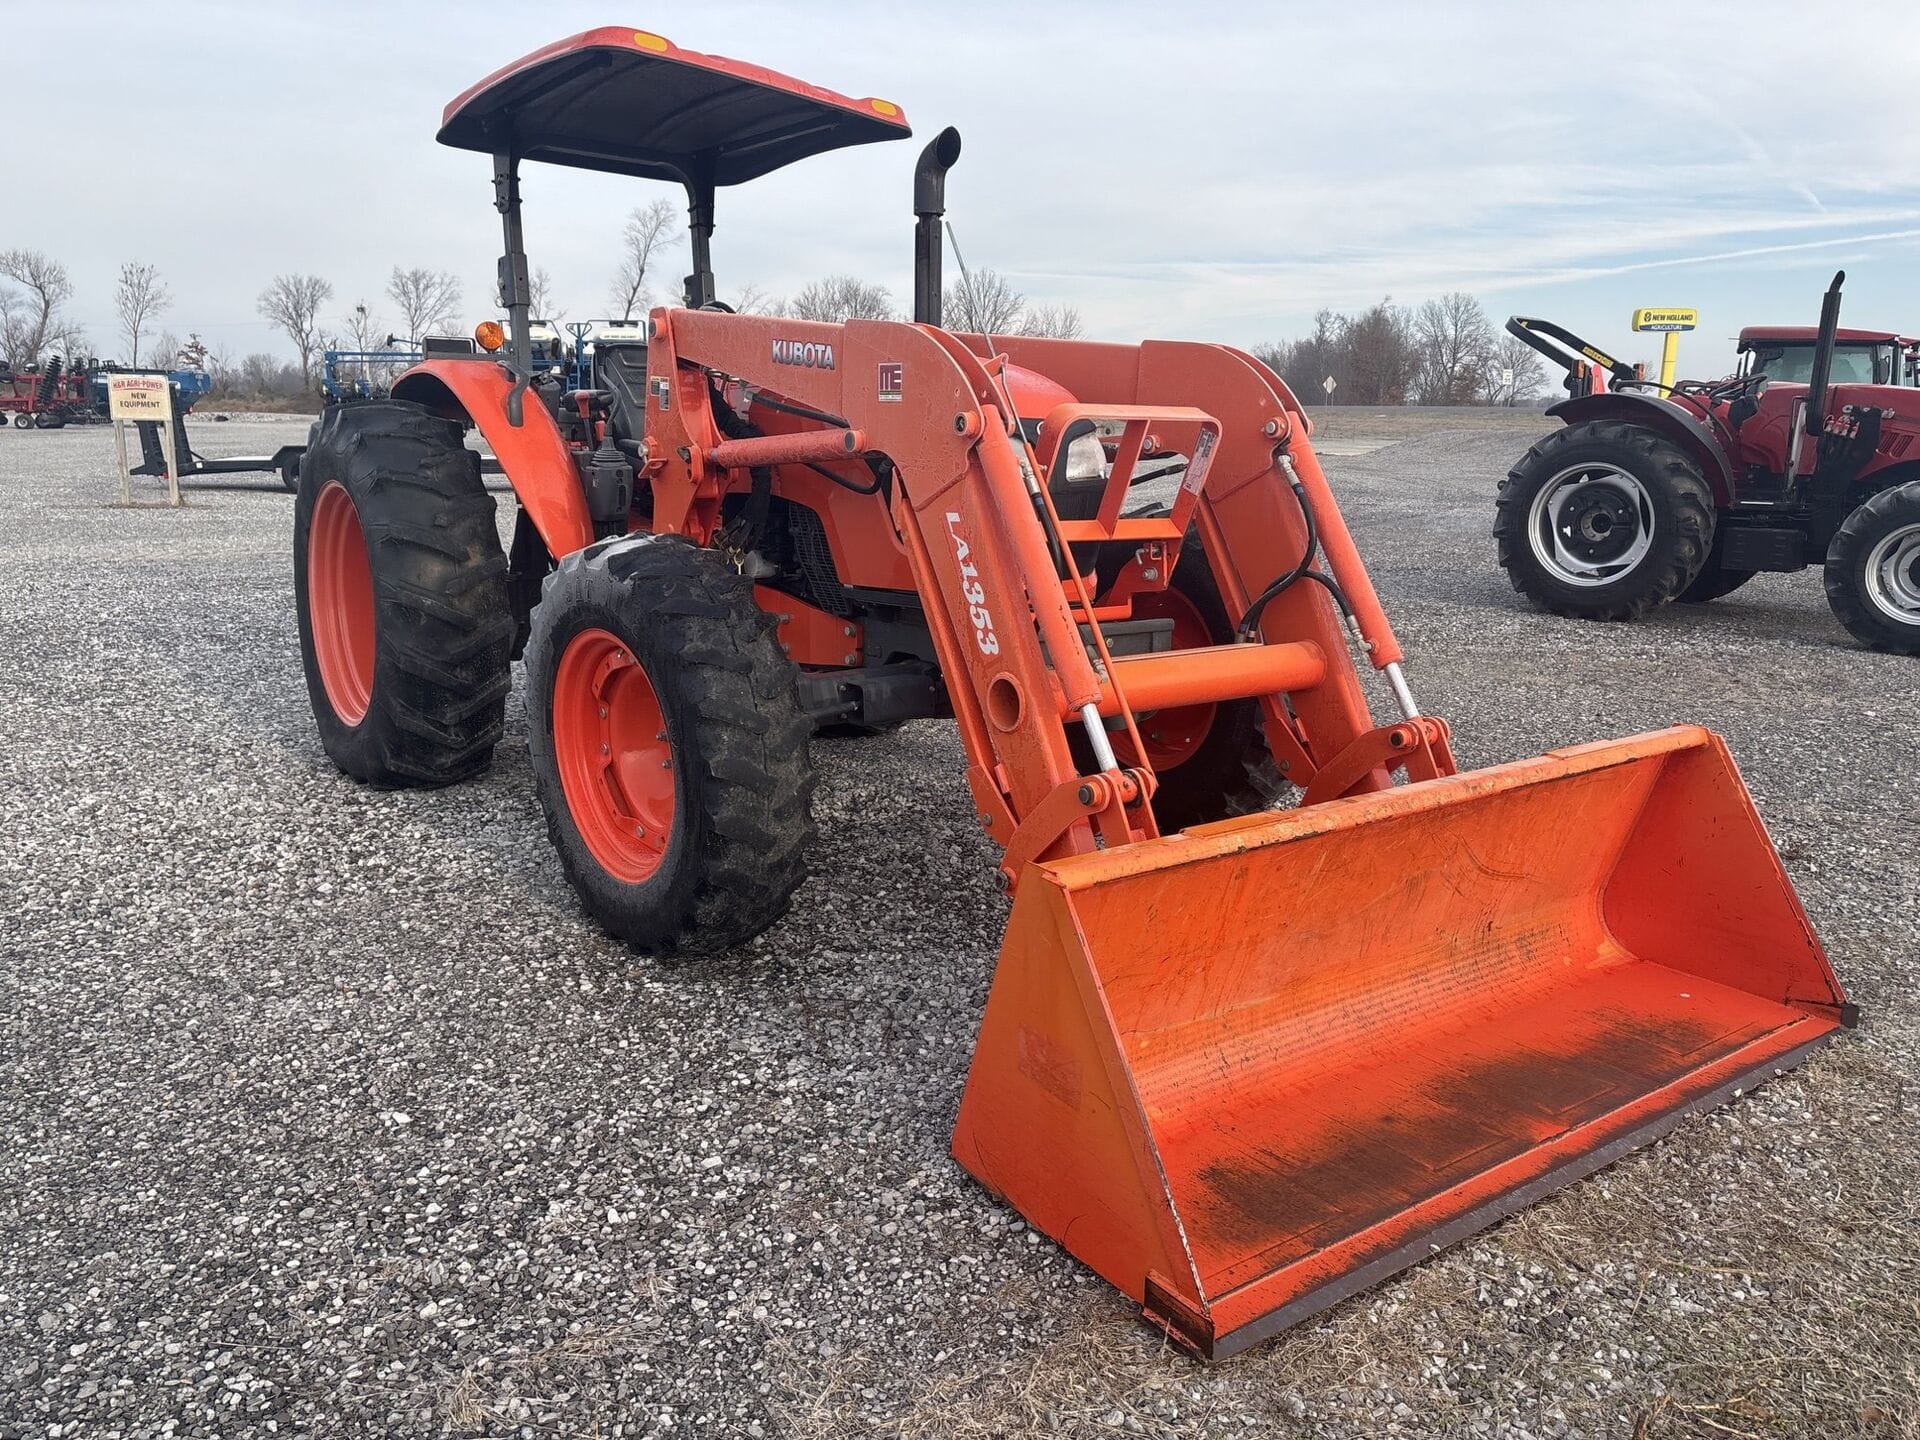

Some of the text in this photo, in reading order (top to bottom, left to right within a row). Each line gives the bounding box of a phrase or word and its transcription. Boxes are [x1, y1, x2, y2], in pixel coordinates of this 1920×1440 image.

[772, 340, 835, 370] KUBOTA
[120, 400, 160, 408] EQUIPMENT
[945, 512, 1000, 656] LA1353
